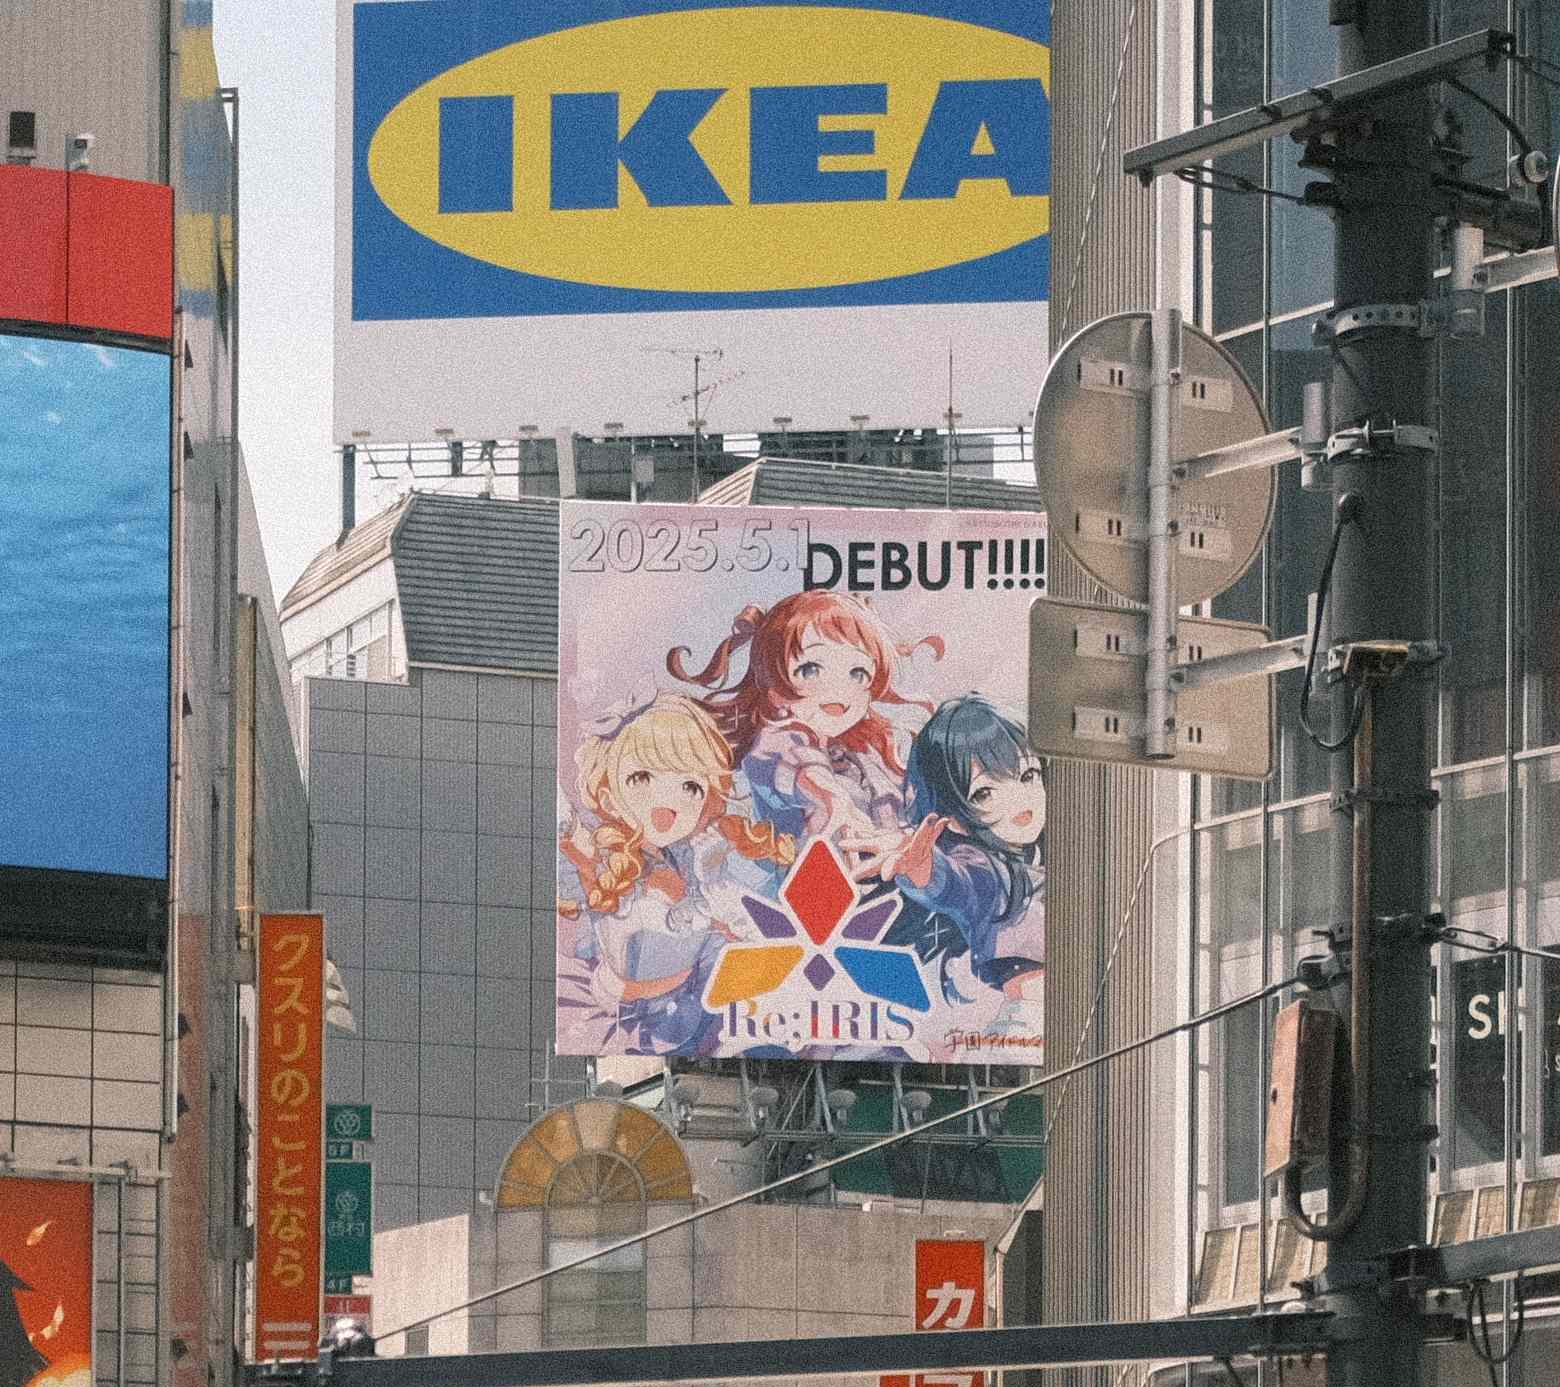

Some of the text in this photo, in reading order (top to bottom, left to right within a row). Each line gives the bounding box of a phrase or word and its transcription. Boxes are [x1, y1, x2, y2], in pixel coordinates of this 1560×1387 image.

[436, 79, 1050, 213] IKEA
[568, 516, 1045, 593] 2025.5.1 DEBUT!!!!
[269, 932, 310, 1288] クスリのことなら
